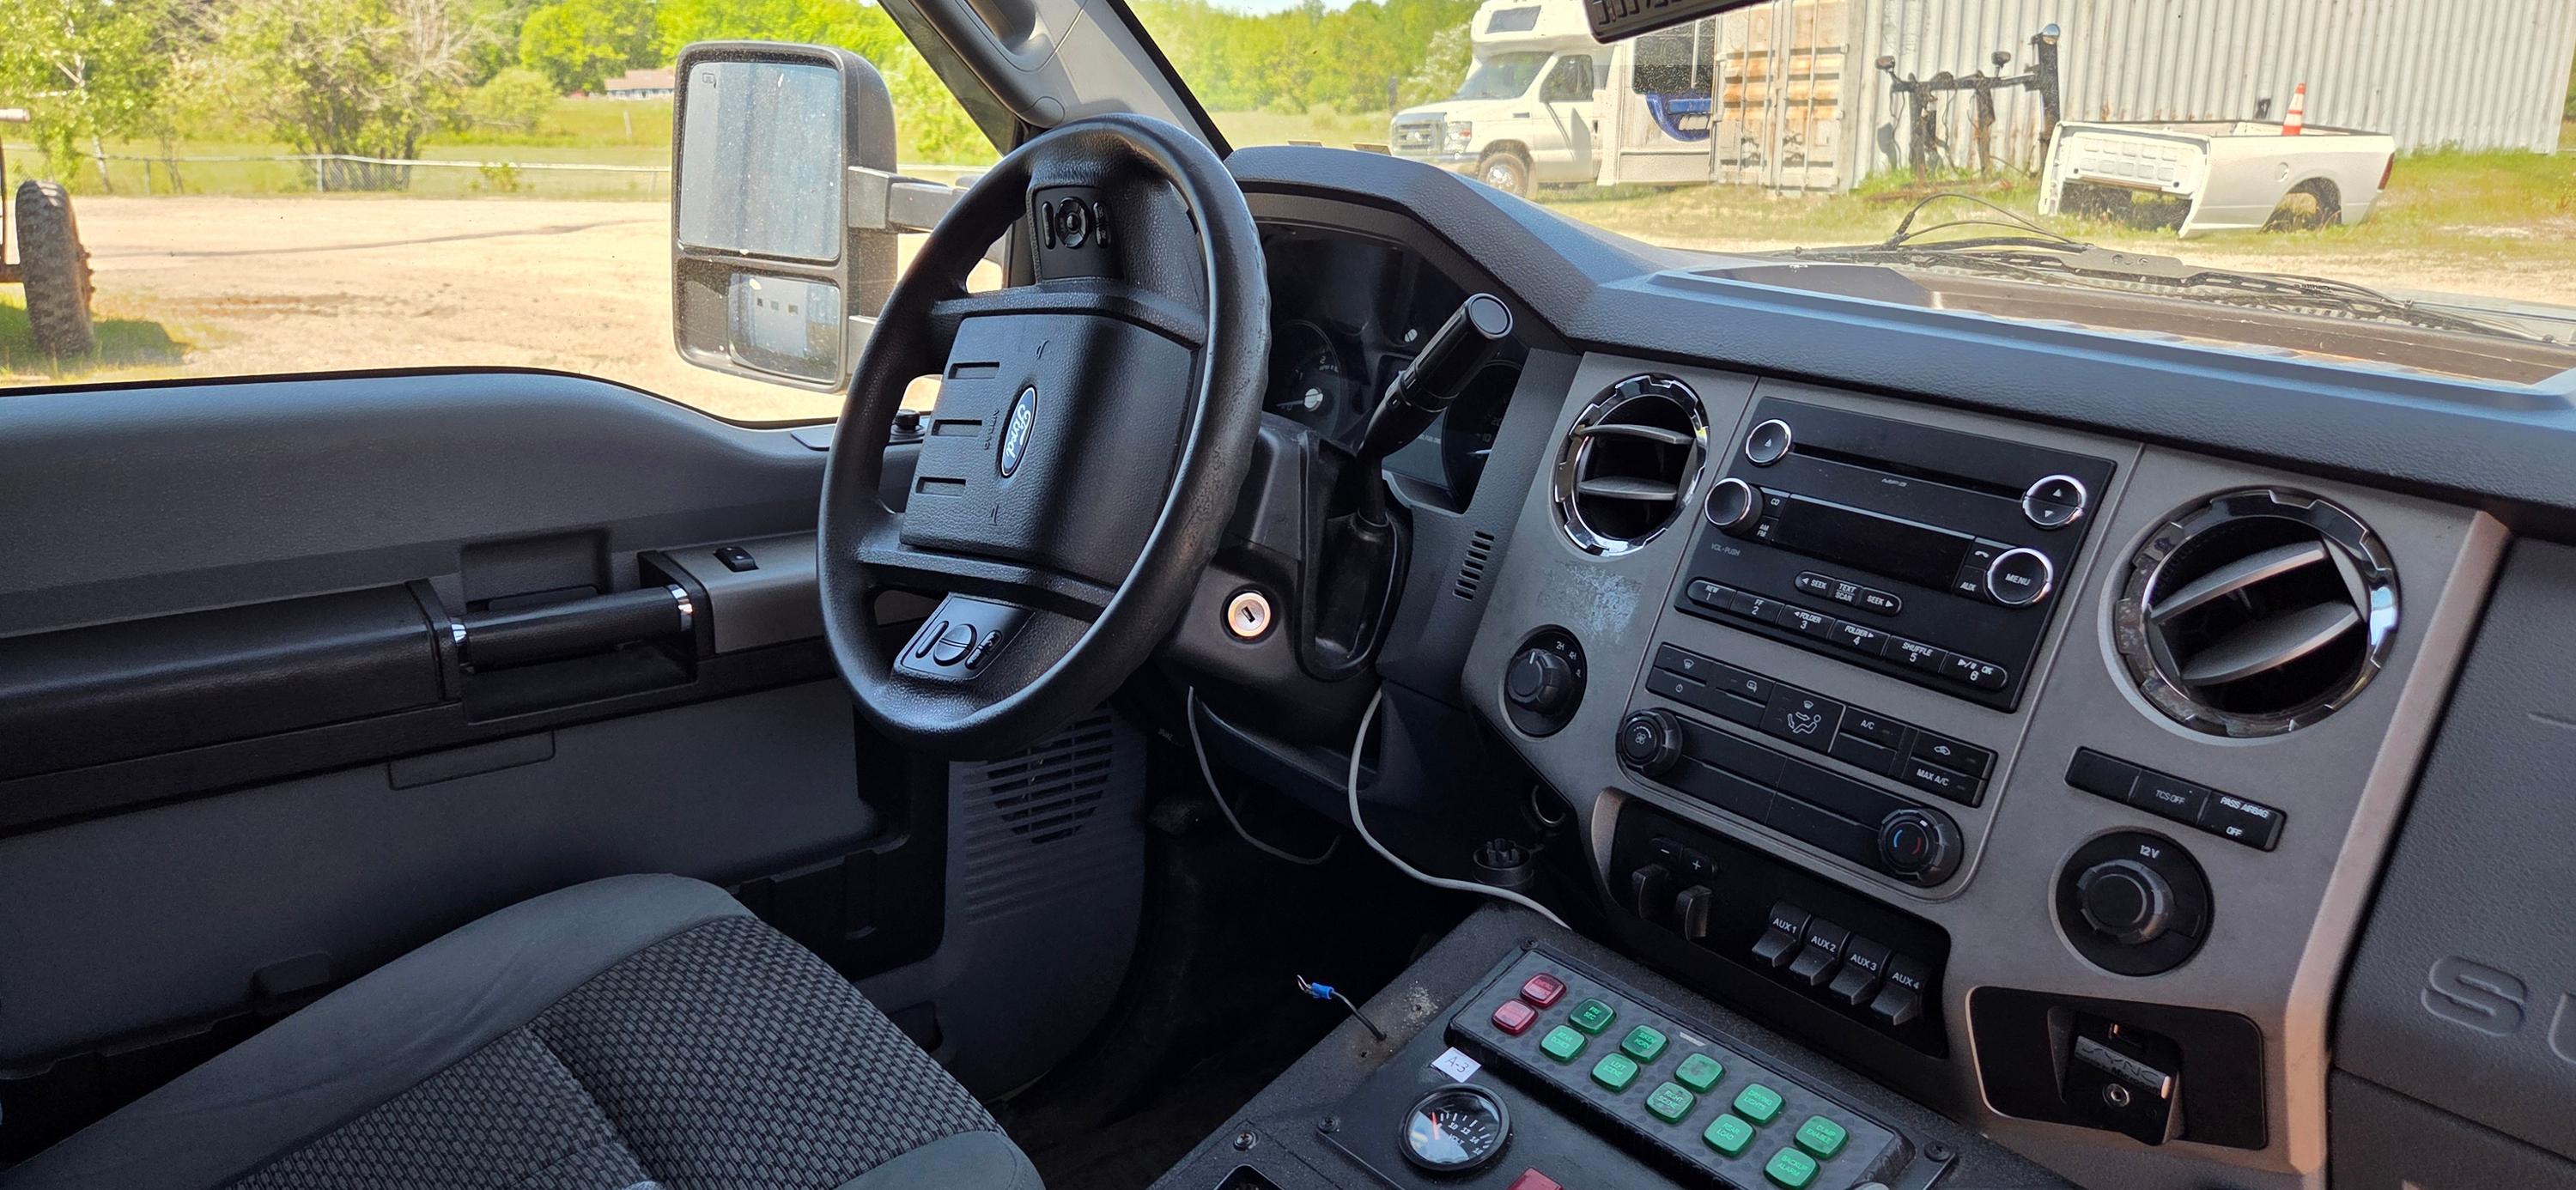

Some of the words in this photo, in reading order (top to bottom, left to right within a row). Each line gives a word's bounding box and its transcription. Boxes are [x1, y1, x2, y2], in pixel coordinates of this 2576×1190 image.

[1005, 404, 1031, 458] Ford
[1759, 523, 1770, 531] AM
[1810, 579, 1826, 590] SEEK
[2005, 573, 2031, 586] MENU
[1705, 585, 1718, 594] REW
[1839, 583, 1856, 593] TEXT
[1959, 581, 1977, 592] AUX
[1705, 592, 1711, 601] 1
[1834, 592, 1854, 602] SCAN
[1867, 595, 1884, 606] SEEK
[1751, 606, 1759, 616] 2
[1798, 612, 1822, 624] FOLDER
[1800, 620, 1807, 630] 3
[1844, 625, 1868, 638] FOLDER
[1556, 641, 1565, 651] 2H
[1853, 636, 1861, 646] 4
[1902, 641, 1932, 657] SHUFFLE
[1909, 653, 1917, 663] 5
[1970, 671, 1979, 681] 6
[1981, 665, 1993, 675] OK
[1860, 719, 1874, 730] A/C
[1916, 768, 1934, 781] MAX
[1934, 775, 1949, 786] A/C
[2155, 789, 2171, 801] TCS
[2169, 795, 2185, 804] OFF
[2220, 796, 2241, 810] PASS
[2239, 802, 2269, 818] AIRBAG
[2226, 825, 2244, 836] OFF
[1772, 917, 1792, 931] AUX
[1810, 935, 1830, 949] AUX
[1828, 943, 1837, 953] 2
[1850, 953, 1870, 968] AUX
[1869, 961, 1878, 972] 3
[1892, 971, 1912, 986] AUX
[1912, 981, 1921, 990] 4
[1444, 1056, 1471, 1073] A-3
[1610, 1059, 1626, 1071] LEFT
[2082, 1047, 2160, 1085] SYNC
[1663, 1090, 1684, 1103] RIGHT
[1743, 1096, 1766, 1111] LIGHTS
[1716, 1128, 1735, 1141] LOAD
[1722, 1122, 1741, 1135] REAR
[1777, 1162, 1801, 1176] ALARM
